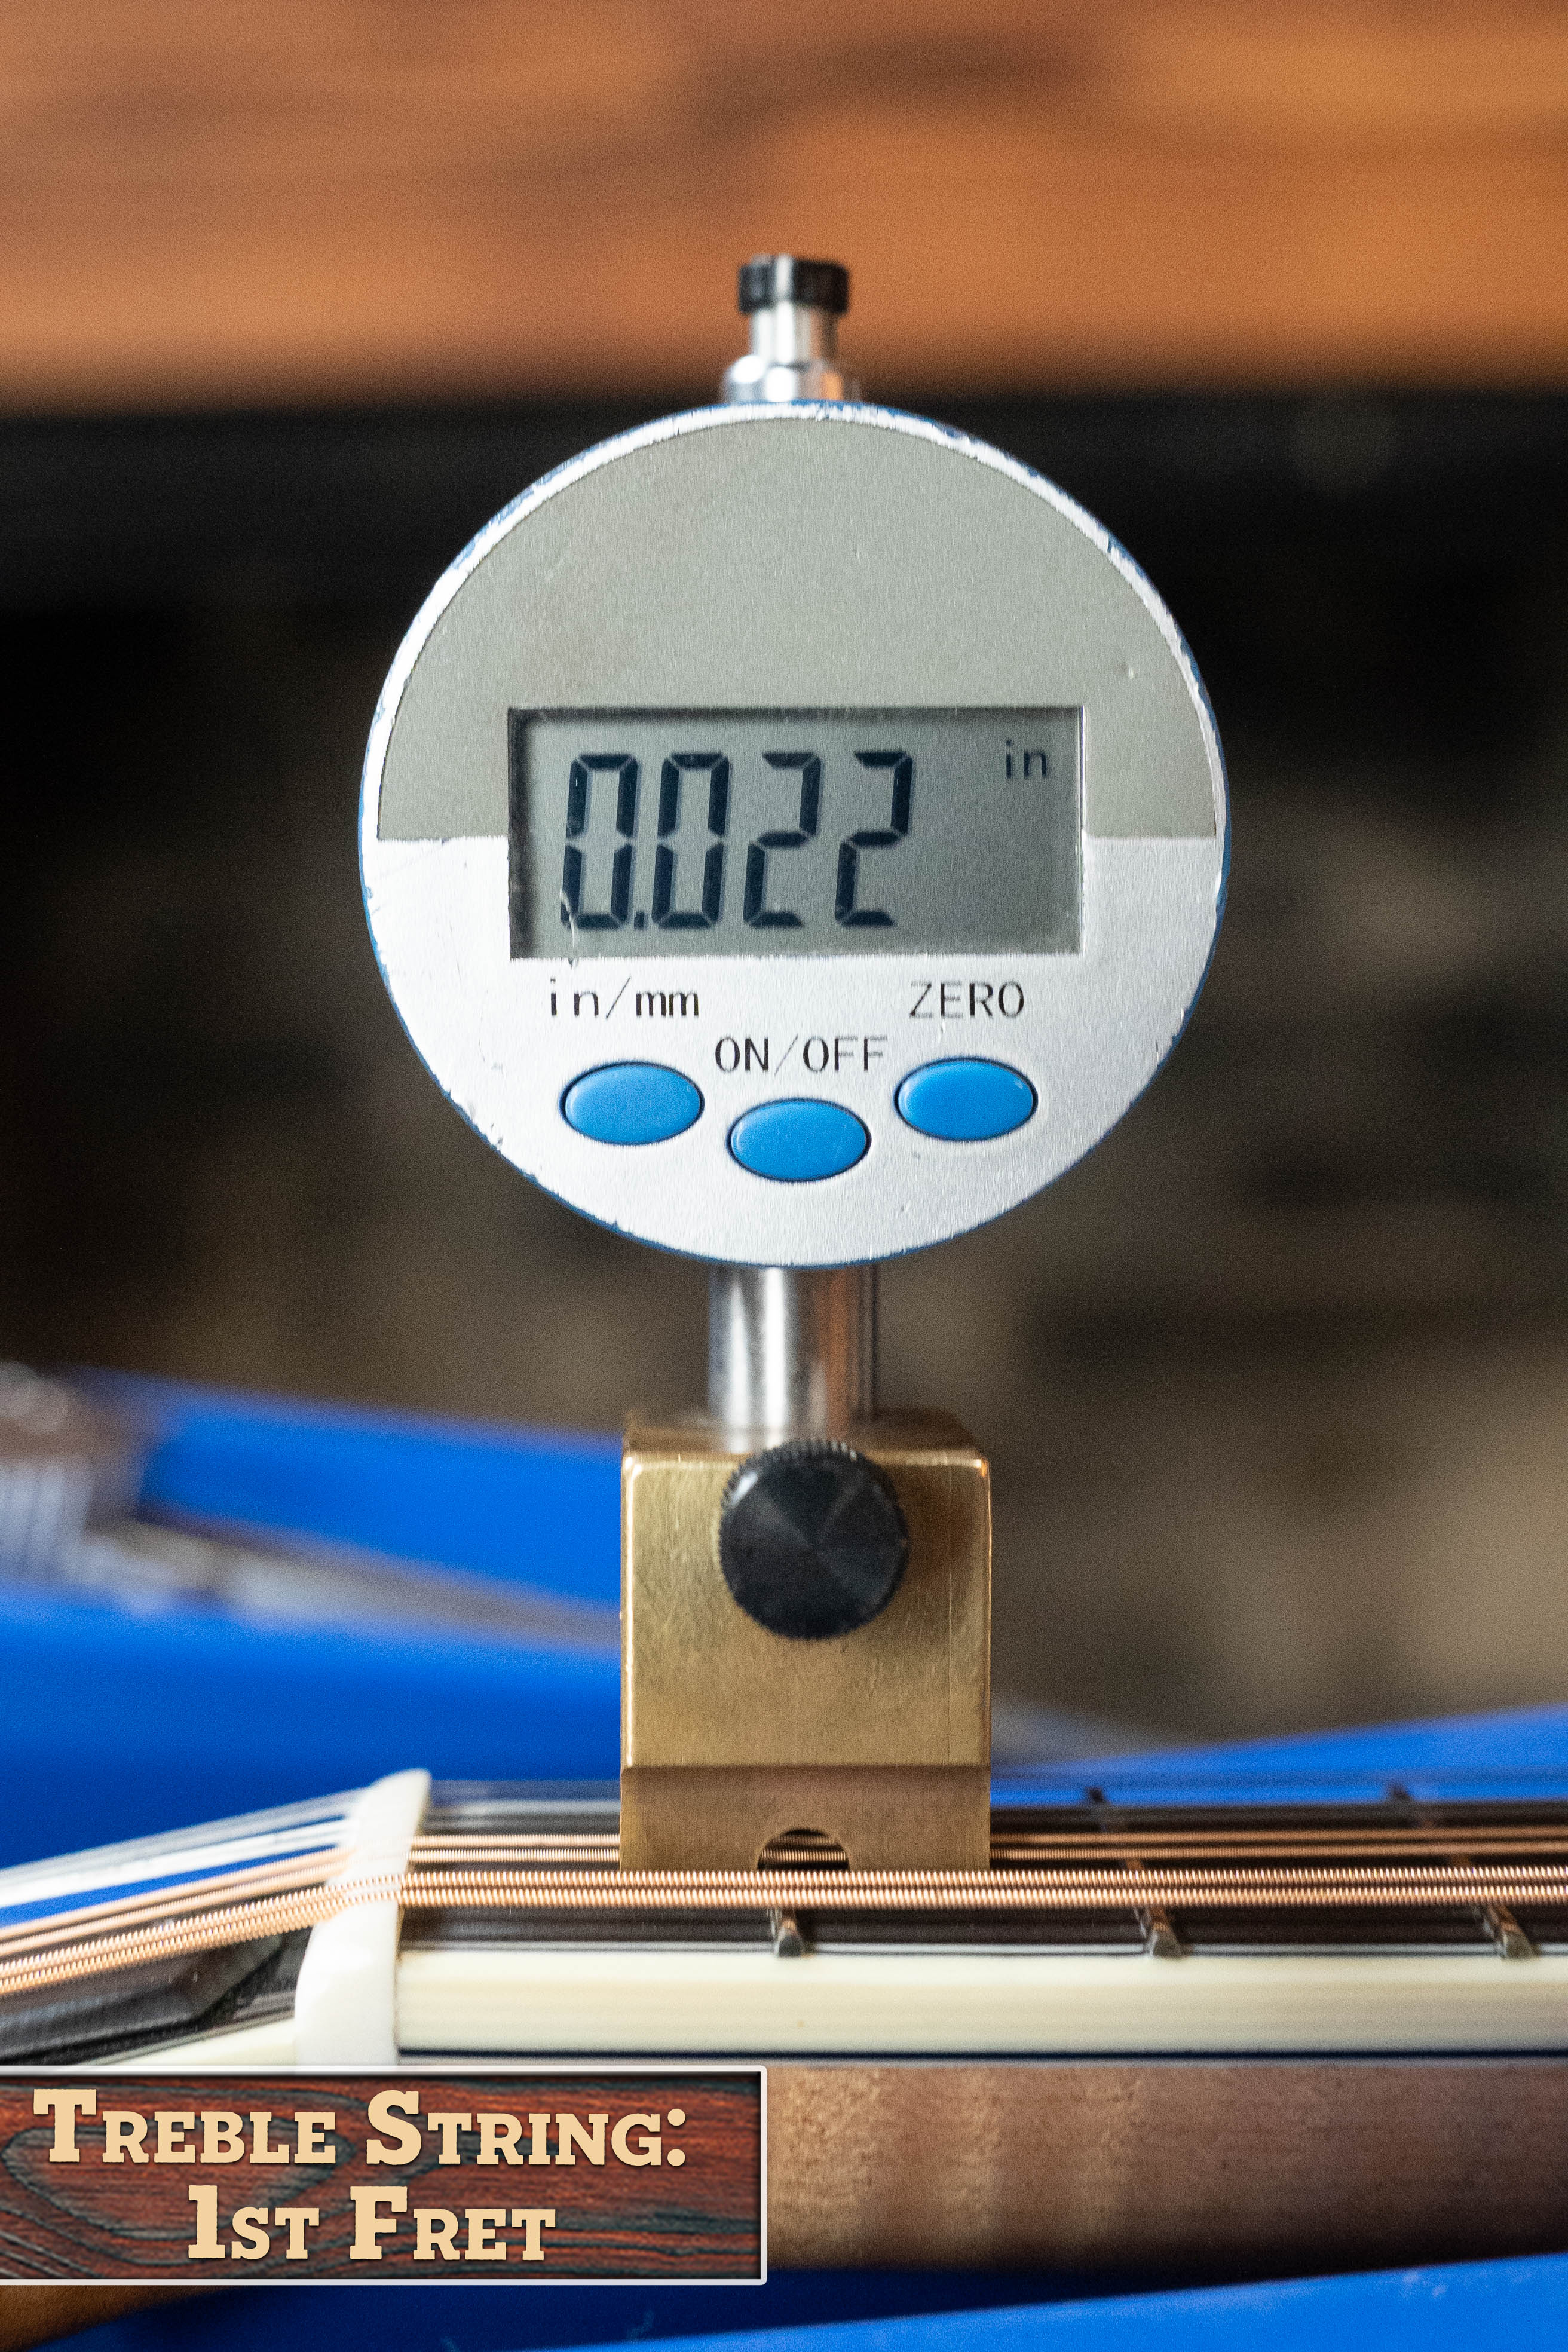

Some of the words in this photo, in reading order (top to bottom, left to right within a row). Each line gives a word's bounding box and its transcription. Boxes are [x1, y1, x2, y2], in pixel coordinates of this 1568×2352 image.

[1005, 739, 1049, 780] in
[560, 751, 913, 929] 0.022
[550, 976, 700, 1019] in/mm
[909, 980, 1025, 1019] ZERO
[715, 1034, 888, 1076] ON/OFF
